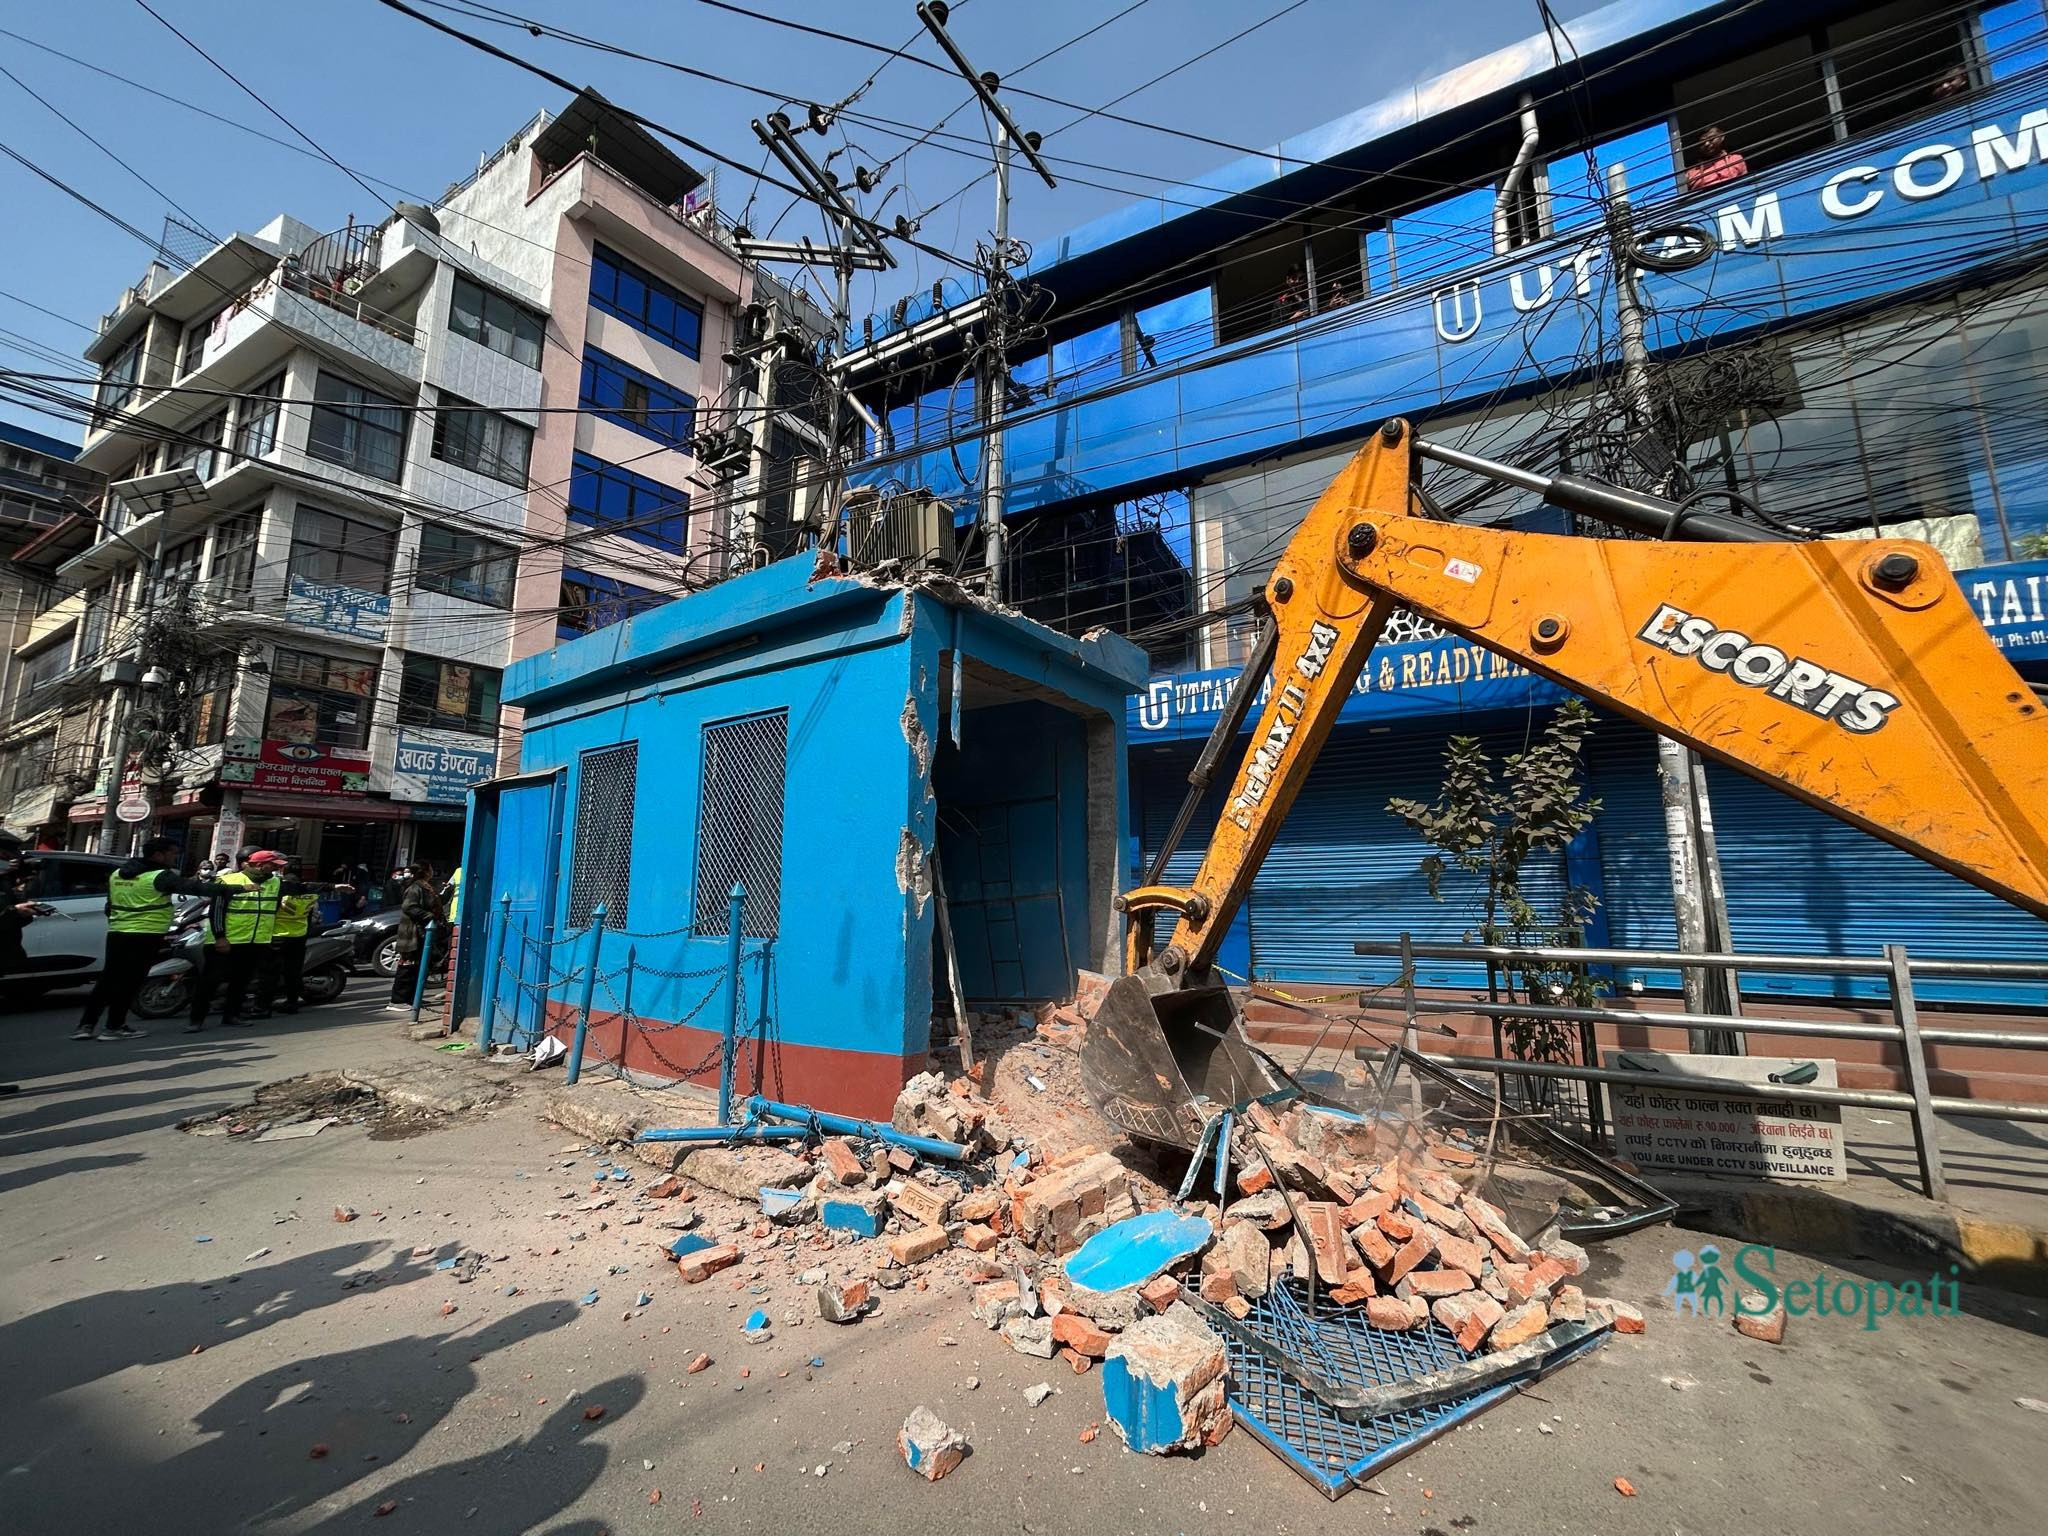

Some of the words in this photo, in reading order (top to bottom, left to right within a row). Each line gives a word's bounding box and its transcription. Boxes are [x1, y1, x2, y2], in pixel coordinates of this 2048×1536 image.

[1973, 576, 2048, 627] TAI
[1378, 656, 1396, 691] &
[1638, 604, 1900, 733] ESCORTS
[1657, 1137, 1688, 1148] CCTV
[1631, 1151, 1652, 1162] YOU
[1655, 1154, 1675, 1164] ARE
[1677, 1155, 1714, 1167] UNDER
[1717, 1158, 1746, 1170] CCTV
[1748, 1160, 1835, 1177] SURVEILLANCE
